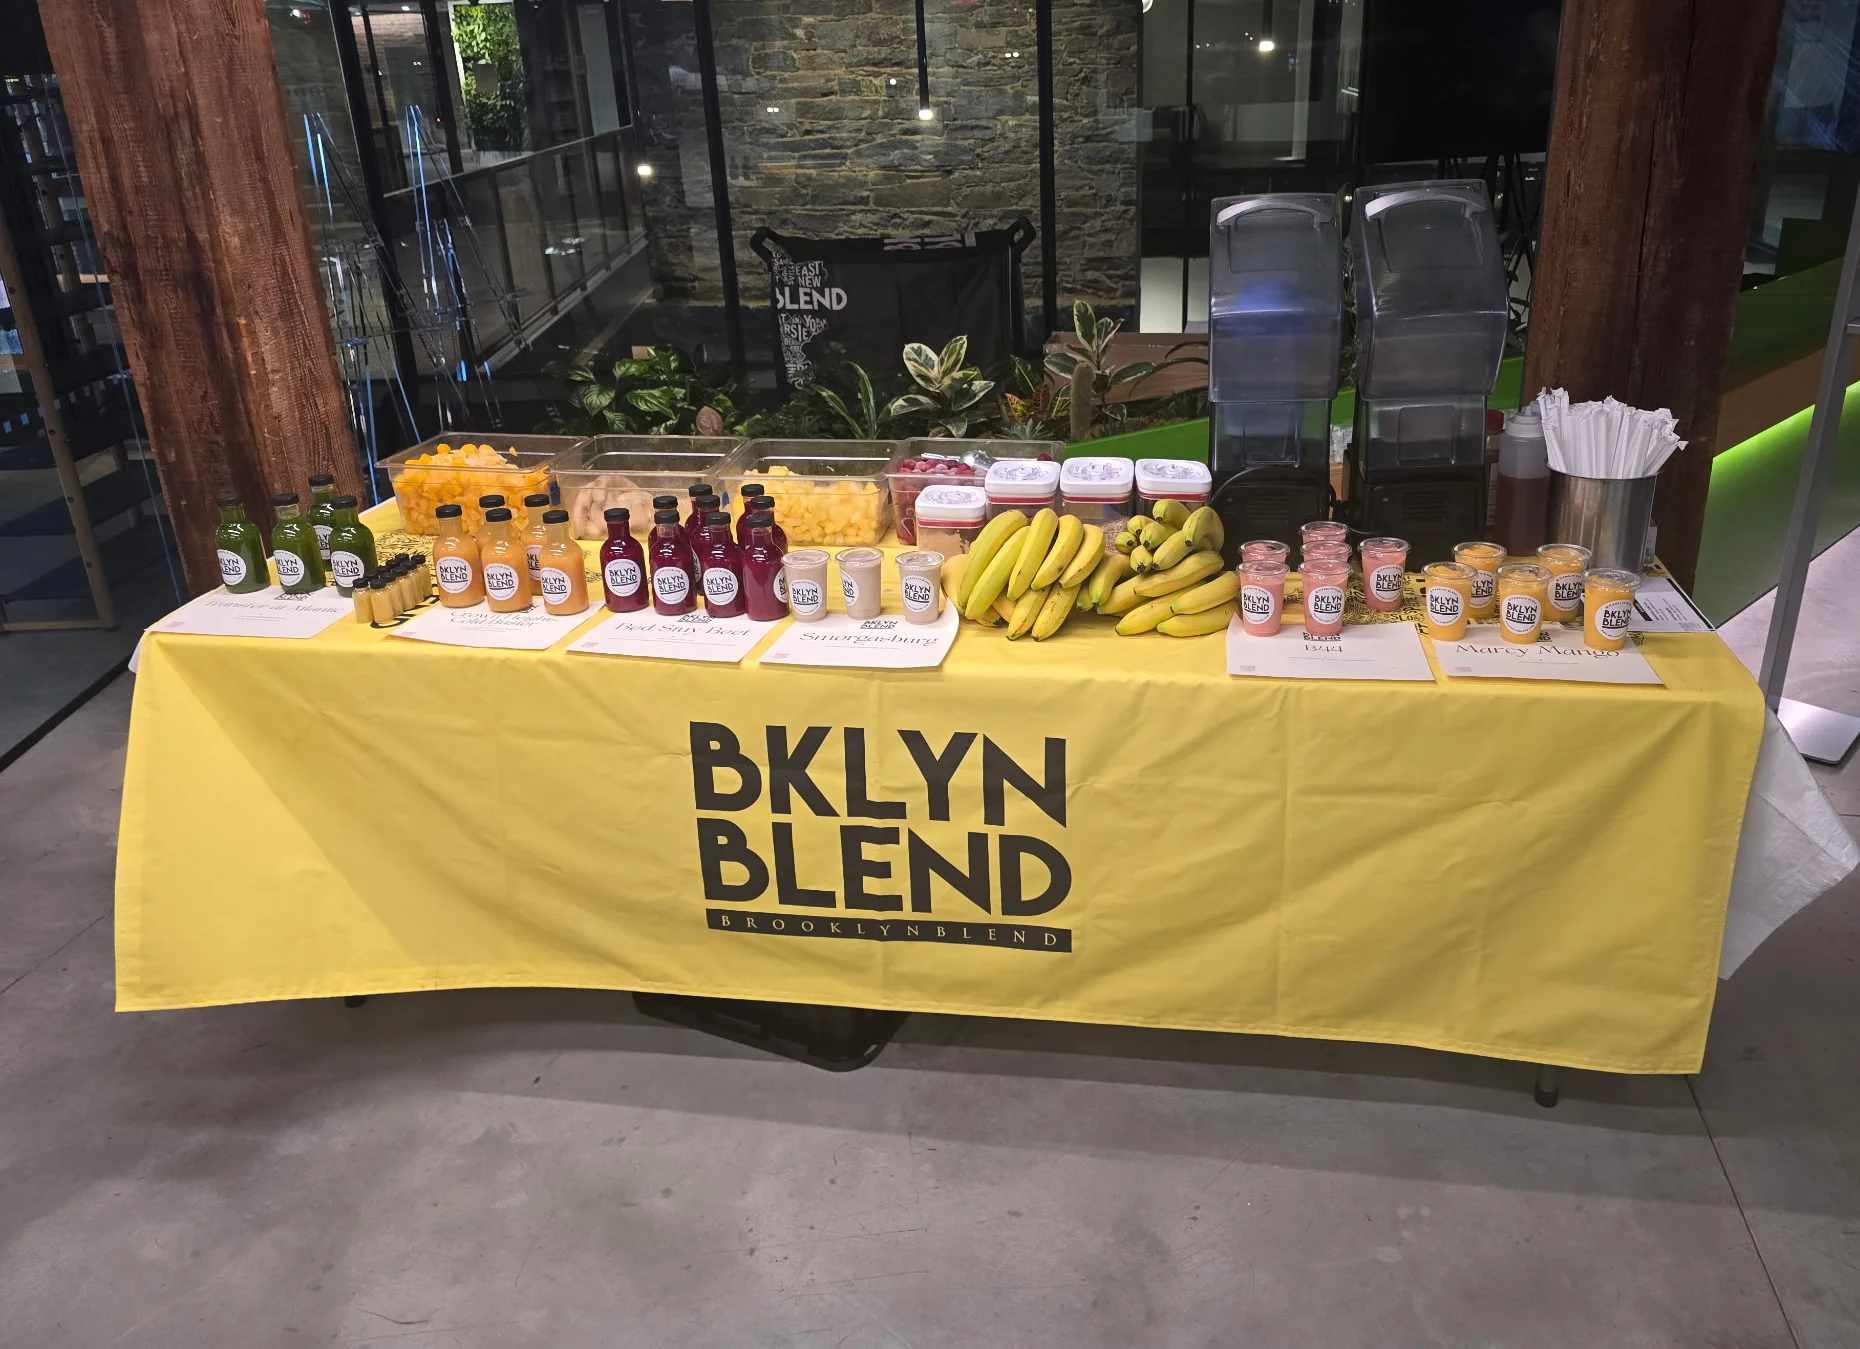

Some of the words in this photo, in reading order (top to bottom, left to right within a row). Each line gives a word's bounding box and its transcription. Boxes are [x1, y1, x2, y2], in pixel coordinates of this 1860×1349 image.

[796, 260, 821, 276] EAST
[798, 276, 821, 288] NEW
[220, 558, 240, 566] KLYN
[608, 566, 636, 577] BKLYN
[1376, 571, 1402, 582] BKLYN
[610, 574, 638, 585] BLEND
[1471, 578, 1494, 589] KLYN
[1375, 581, 1402, 590] BLEND
[1555, 581, 1583, 591] BKLYN
[791, 586, 818, 597] BKLYN
[793, 594, 819, 603] BLEND
[1314, 594, 1342, 604] BKLYN
[1429, 594, 1459, 605] BKLYN
[1313, 601, 1342, 612] BLEND
[1430, 603, 1459, 613] BLEND
[1507, 601, 1538, 614] BKLYN
[1505, 609, 1537, 621] BLEND
[1603, 608, 1632, 619] BKLYN
[615, 622, 657, 632] Bed
[658, 624, 702, 637] Stuy
[706, 626, 751, 637] Beet
[800, 631, 940, 647] Smorgasburg
[1456, 644, 1529, 658] Marcy
[1538, 645, 1620, 659] Mango
[689, 720, 1068, 829] BKLYN
[696, 817, 1073, 917] BLEND
[720, 914, 1058, 947] BROOKLYNBLEND
